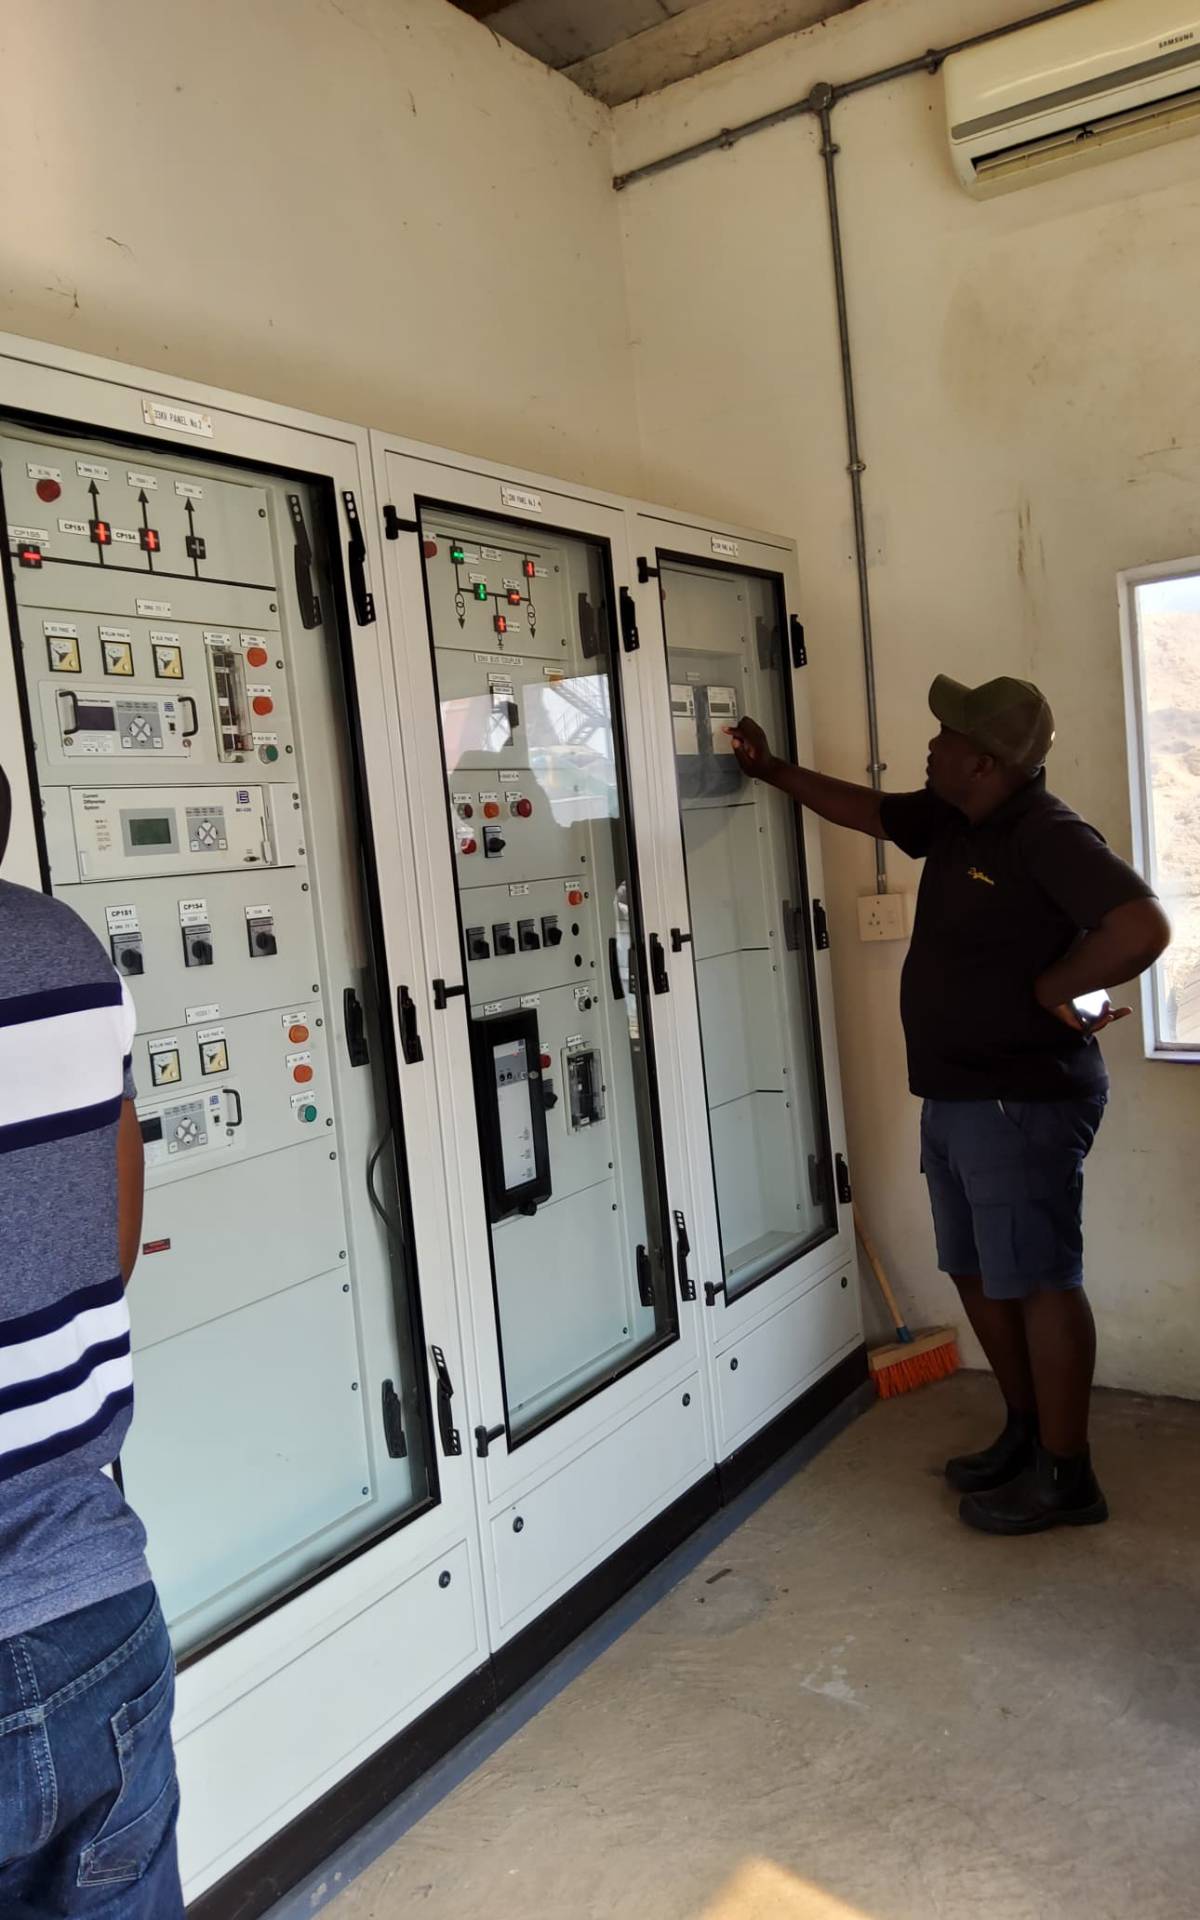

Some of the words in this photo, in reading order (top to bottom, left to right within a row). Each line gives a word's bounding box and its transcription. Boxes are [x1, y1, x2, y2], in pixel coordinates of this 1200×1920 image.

[1158, 32, 1193, 48] SAMSUNG
[64, 522, 86, 532] CP151
[111, 909, 133, 917] CP151
